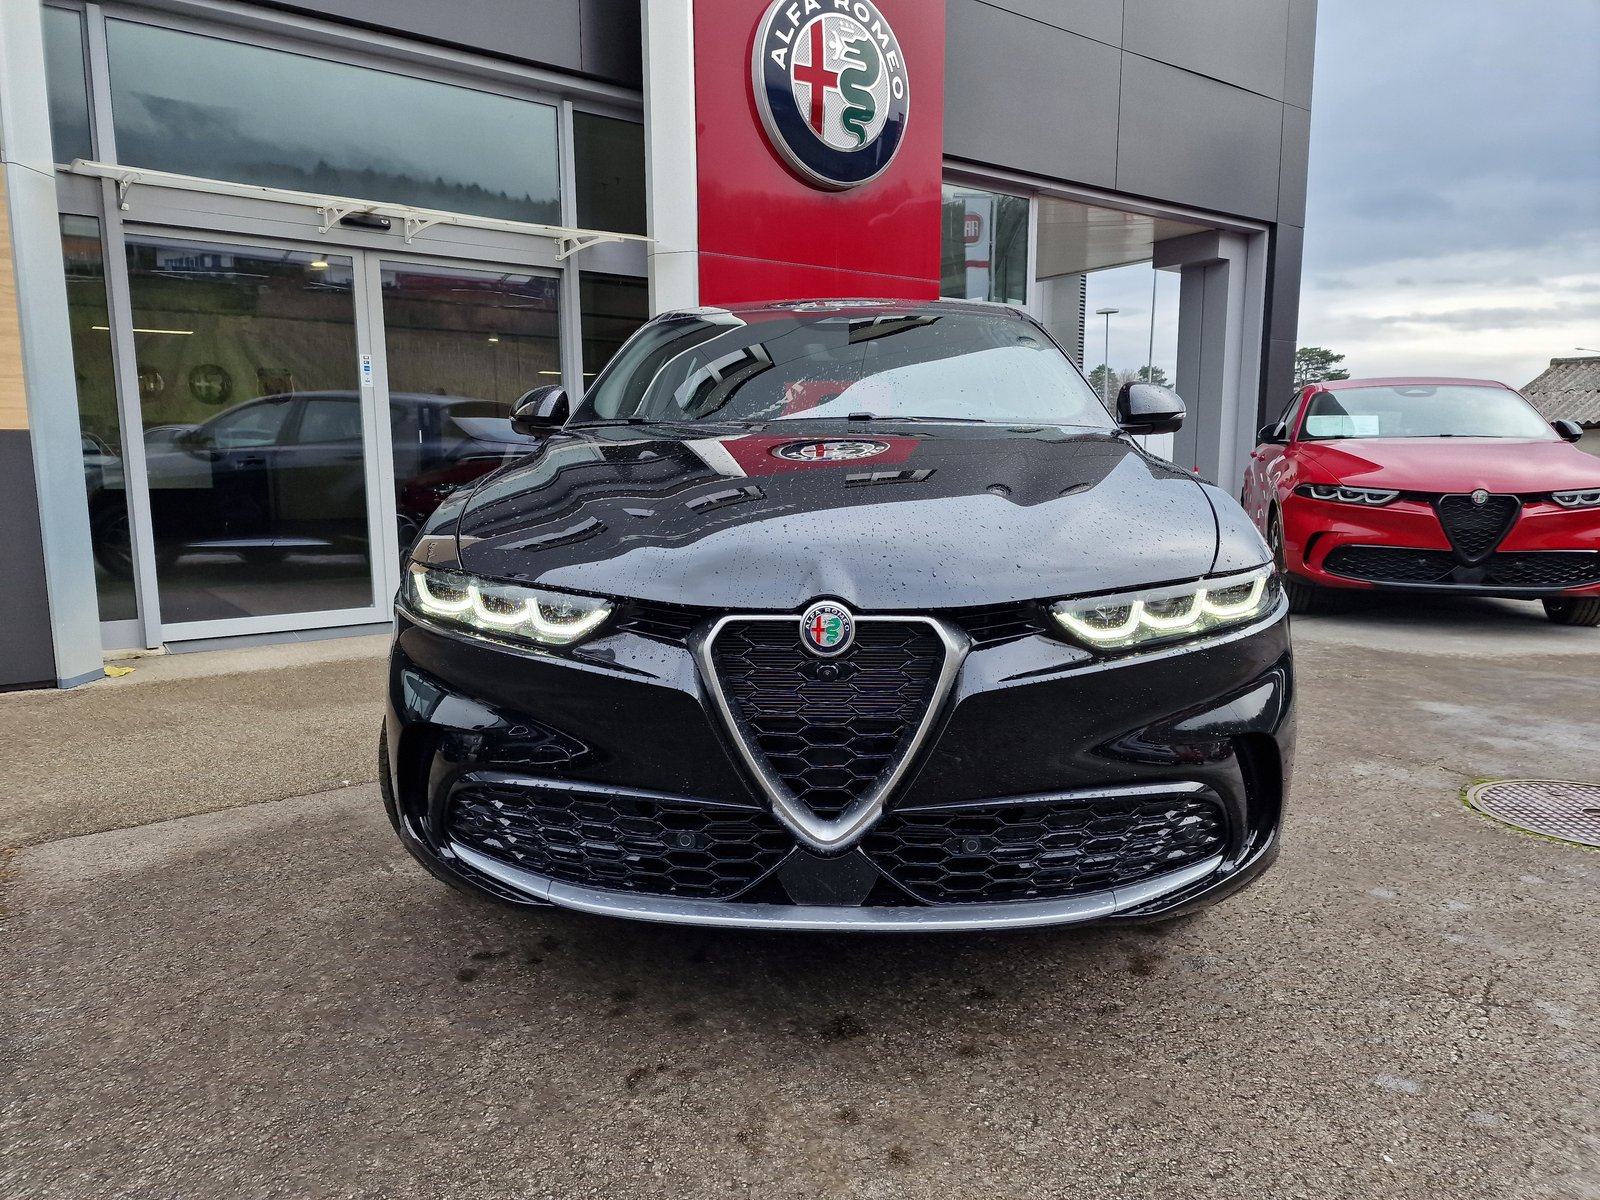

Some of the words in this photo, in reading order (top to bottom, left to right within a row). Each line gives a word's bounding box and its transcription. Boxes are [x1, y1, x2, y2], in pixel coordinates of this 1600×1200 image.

[771, 0, 821, 70] ALFA
[834, 0, 904, 99] ROMEO
[805, 610, 821, 630] ALFA
[824, 608, 850, 631] ROMEO
